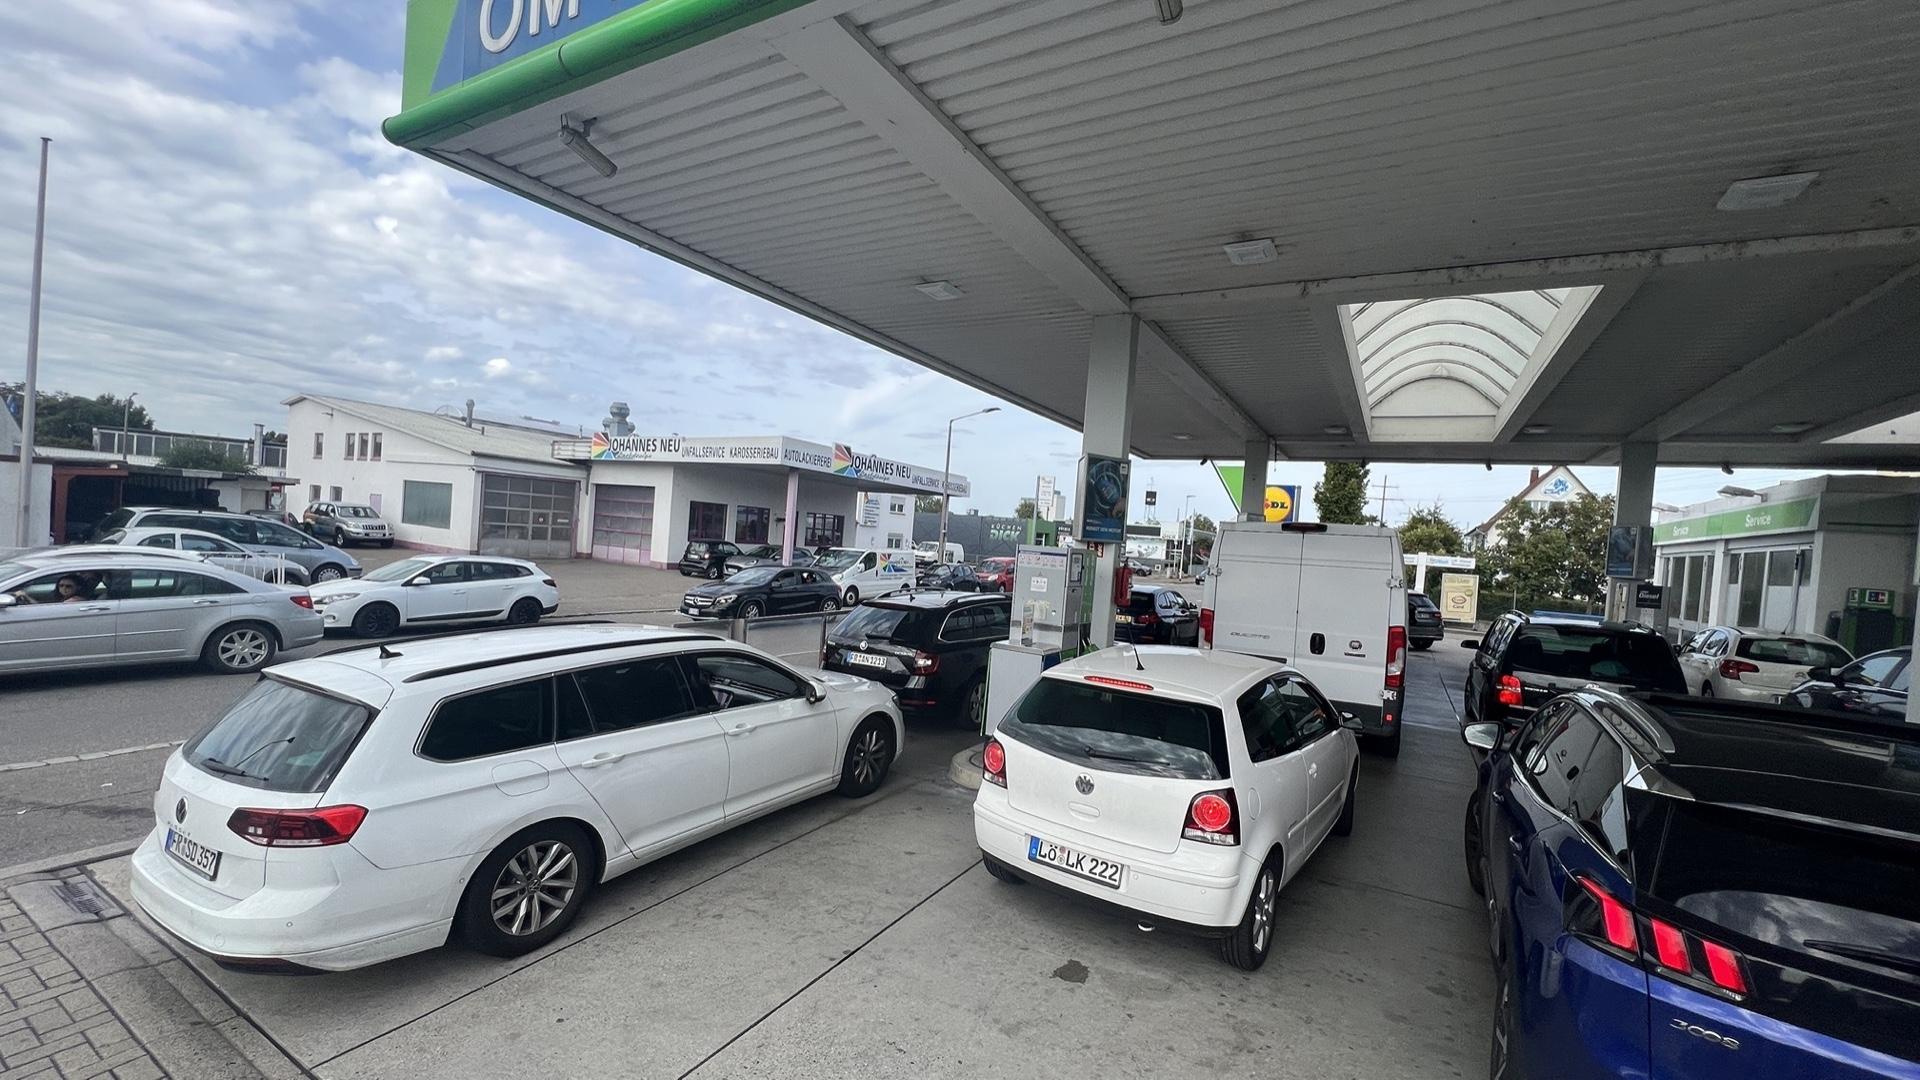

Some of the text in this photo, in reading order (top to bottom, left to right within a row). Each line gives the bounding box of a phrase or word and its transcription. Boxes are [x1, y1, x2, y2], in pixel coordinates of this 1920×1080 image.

[608, 438, 681, 453] JOHANNES NEU
[681, 446, 779, 461] UNFALLSERVICE KAROSSERIEBAU
[784, 448, 832, 469] AUTOLACKIEREREI
[850, 455, 912, 480] JOHANNES NEU
[1745, 513, 1772, 528] Service
[990, 530, 1020, 541] DICK
[1672, 526, 1689, 537] Service
[185, 839, 198, 862] SD
[197, 845, 216, 871] 357
[1037, 840, 1120, 882] LÖ LK 222
[1669, 1018, 1741, 1050] 3008
